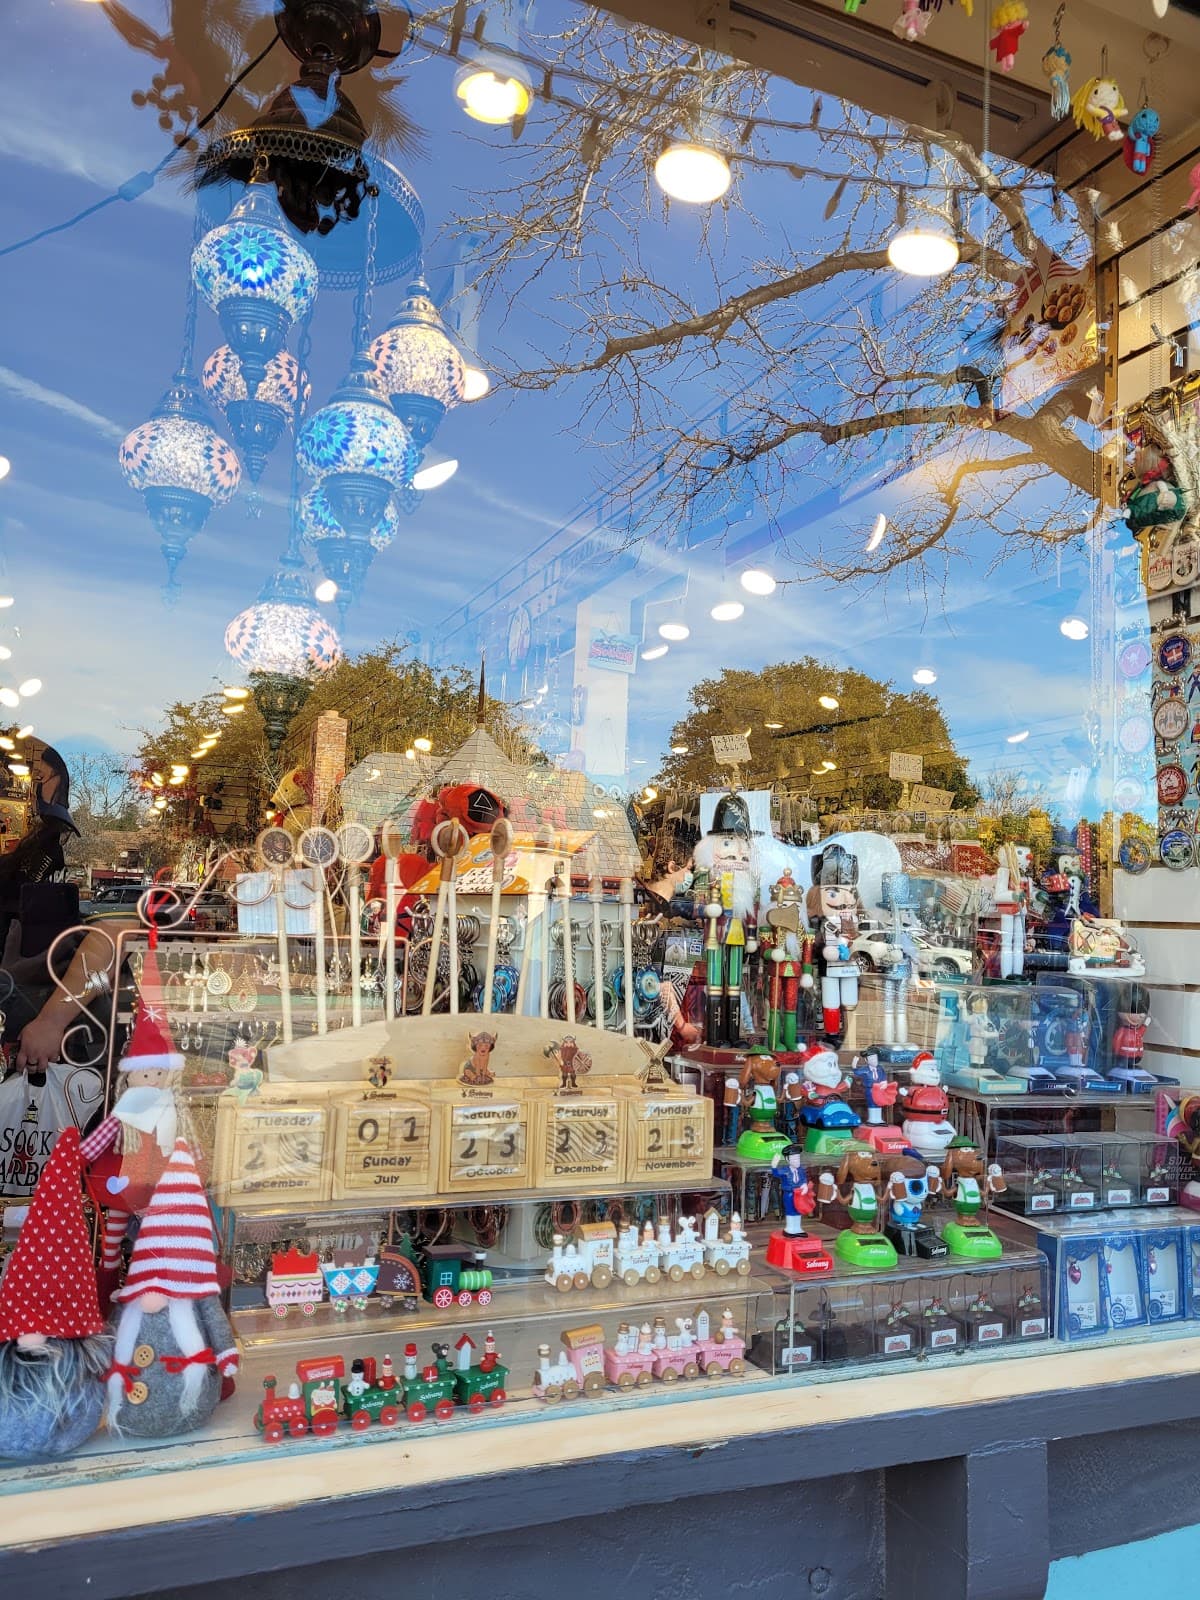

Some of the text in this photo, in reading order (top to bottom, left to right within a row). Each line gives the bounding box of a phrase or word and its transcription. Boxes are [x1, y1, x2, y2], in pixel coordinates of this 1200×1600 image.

[253, 1115, 314, 1128] Tuesday
[0, 1128, 53, 1157] SOCK
[362, 1156, 412, 1169] Sunday
[646, 1161, 696, 1170] November
[1168, 1156, 1192, 1166] SOL
[554, 1165, 608, 1174] December
[374, 1174, 400, 1185] July
[243, 1180, 310, 1190] December
[930, 1246, 947, 1256] Solvang
[806, 1259, 829, 1270] Solvang
